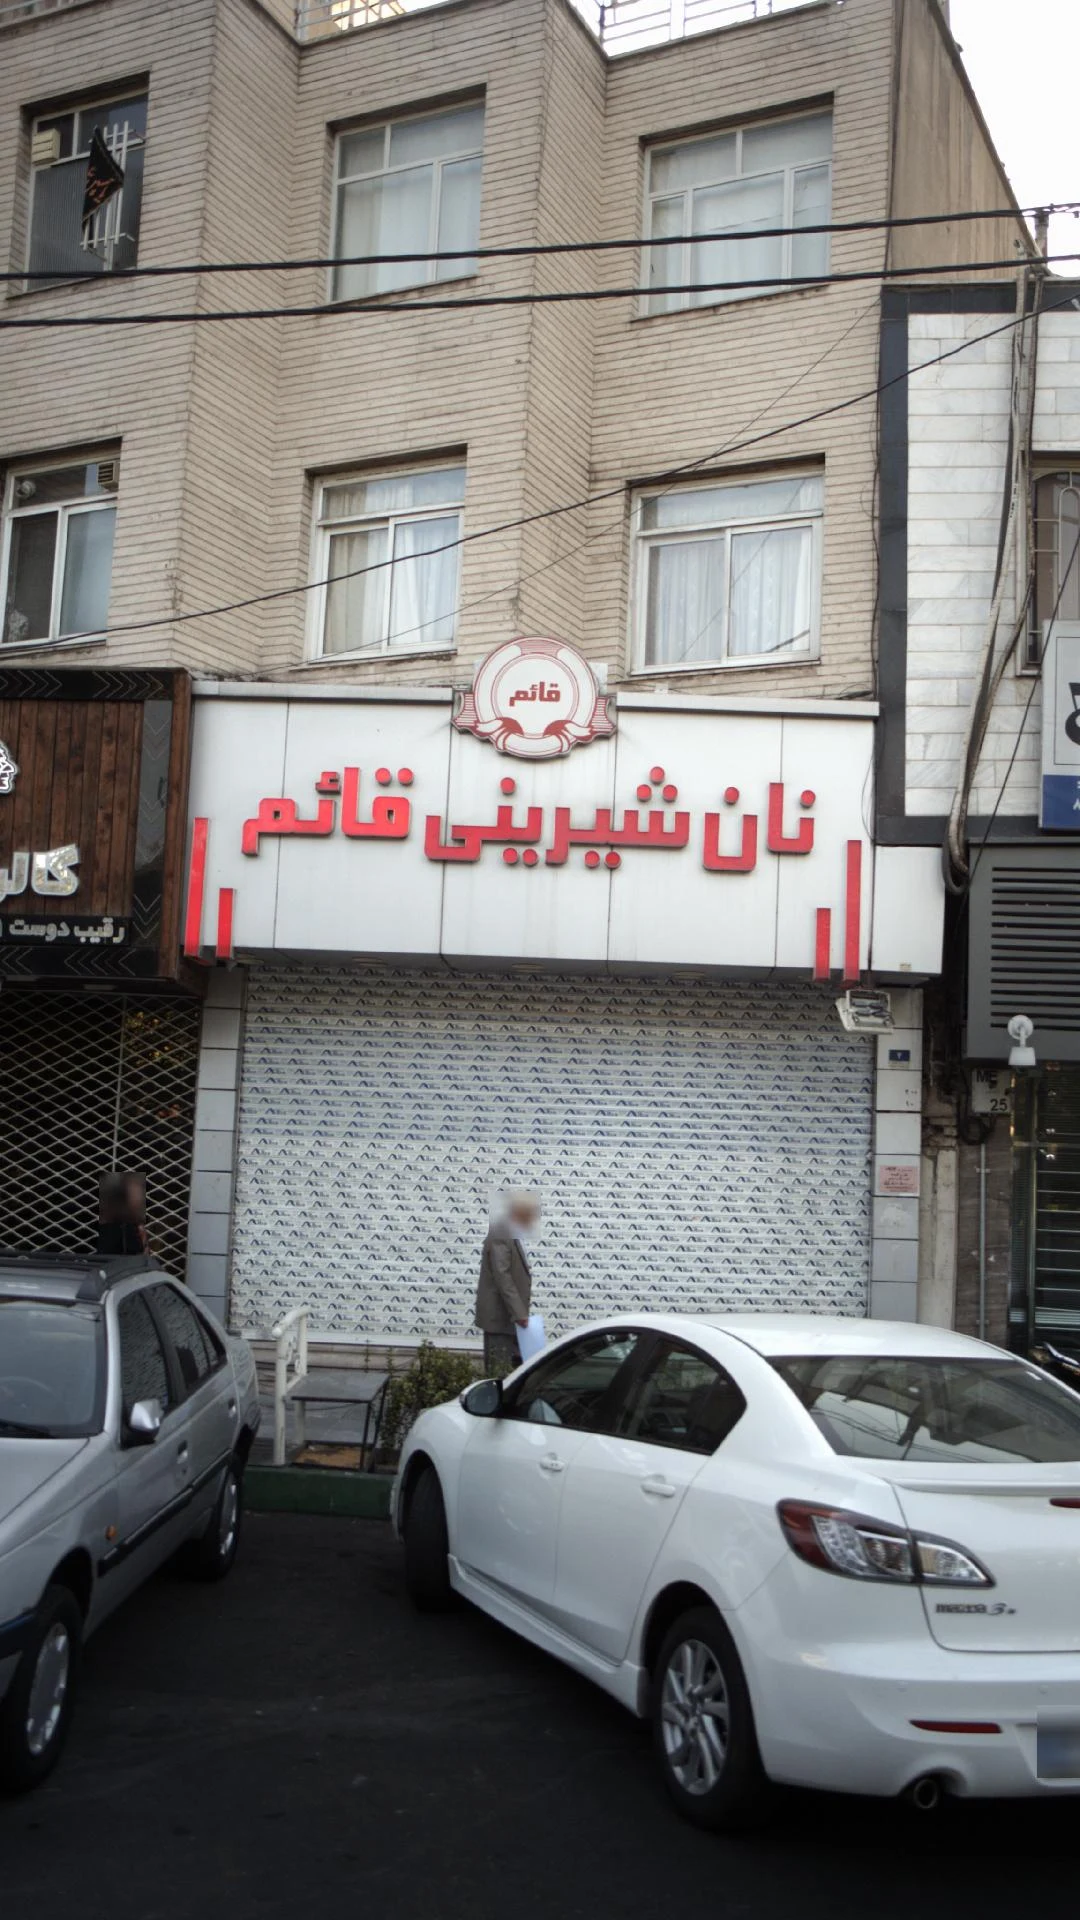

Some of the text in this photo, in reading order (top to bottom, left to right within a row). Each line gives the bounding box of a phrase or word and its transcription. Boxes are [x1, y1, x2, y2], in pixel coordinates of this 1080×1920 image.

[509, 681, 561, 707] قائم
[241, 766, 816, 873] نان شیرینی قائم
[9, 919, 71, 942] دوست
[74, 917, 125, 943] رقیب
[990, 1098, 1008, 1111] 25
